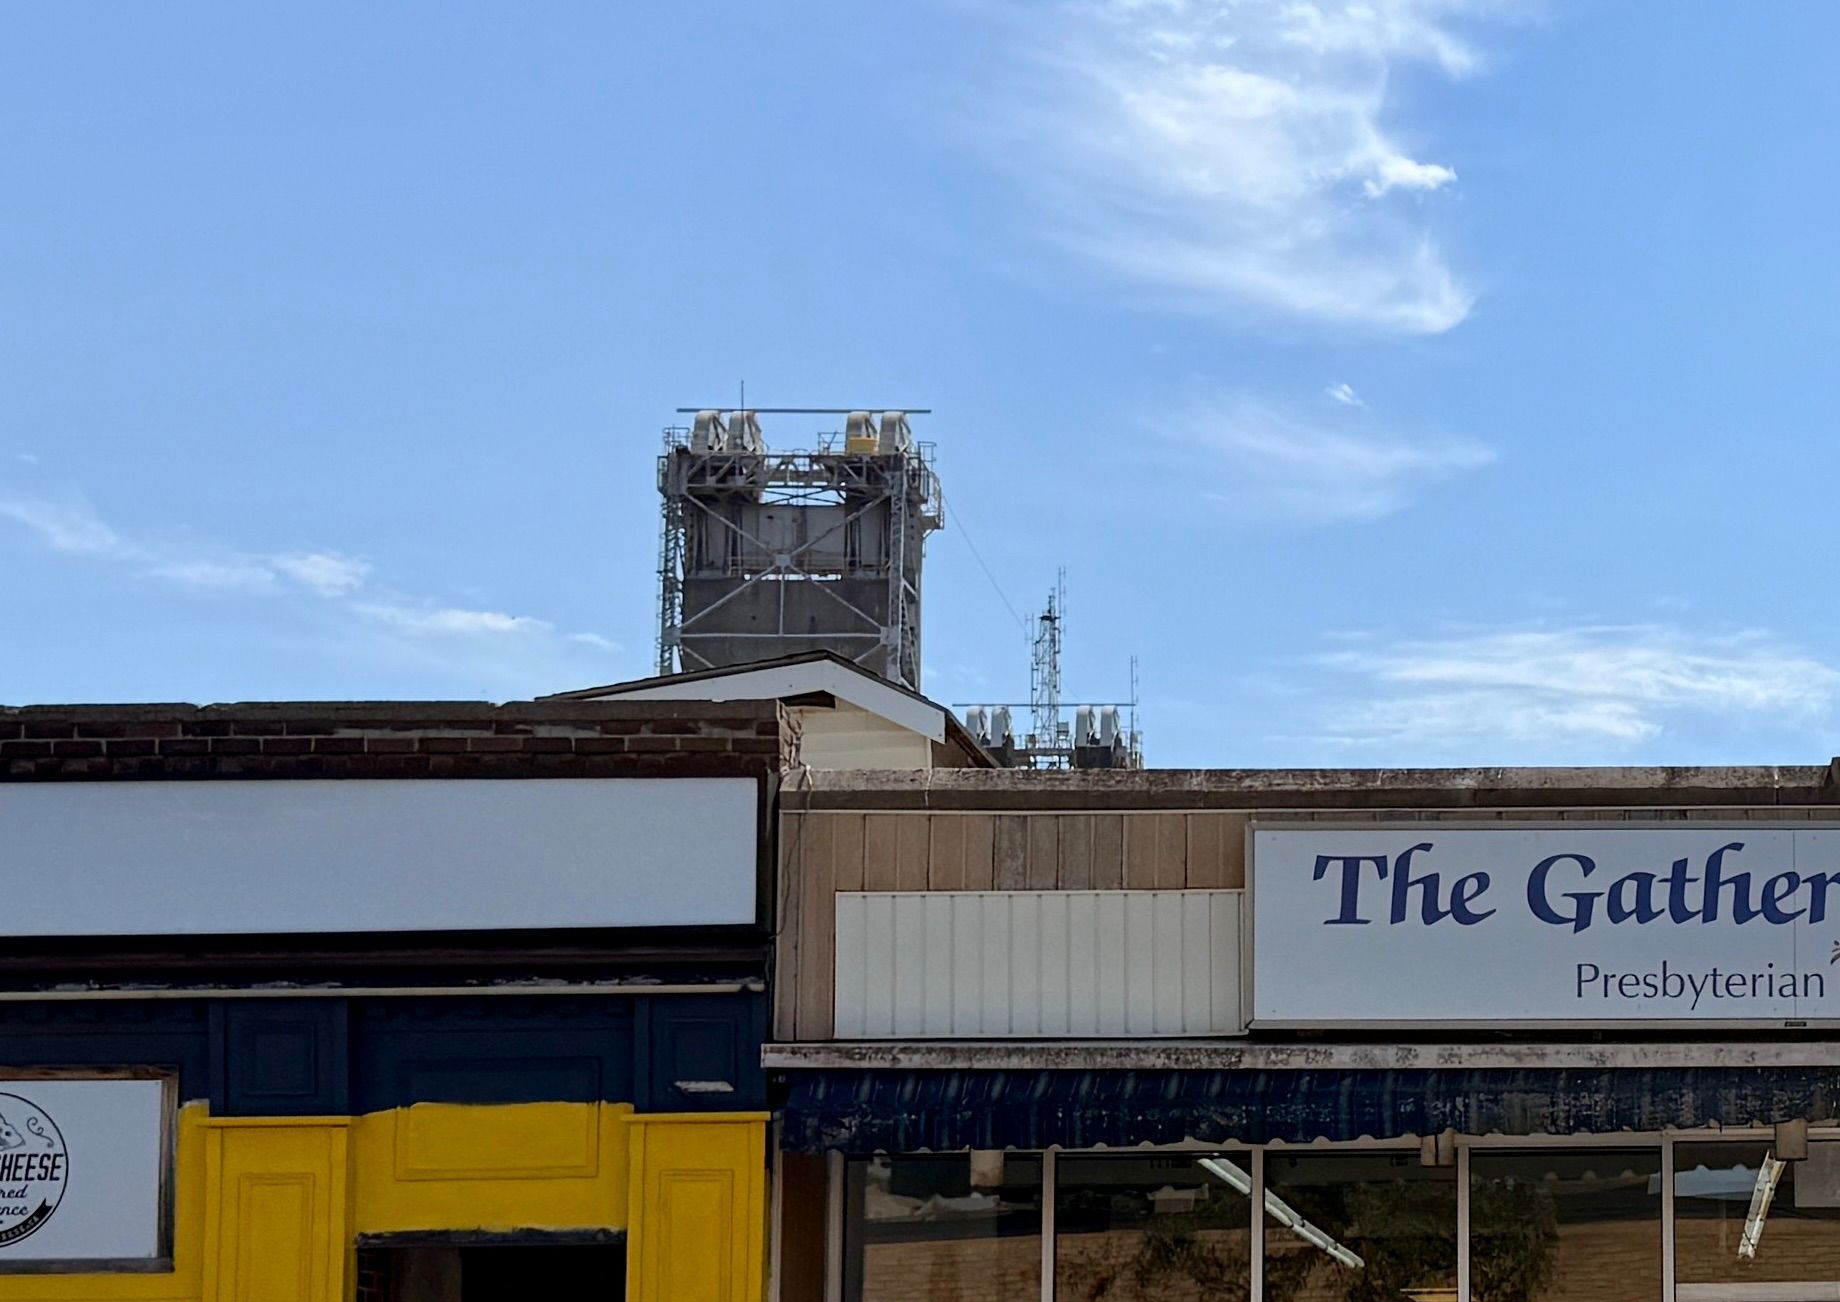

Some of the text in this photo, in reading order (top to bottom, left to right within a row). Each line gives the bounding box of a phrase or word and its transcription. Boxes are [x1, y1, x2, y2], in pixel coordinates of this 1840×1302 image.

[1313, 841, 1497, 927] The
[1577, 961, 1826, 1011] Presbyterian
[0, 1153, 65, 1181] HEESE
